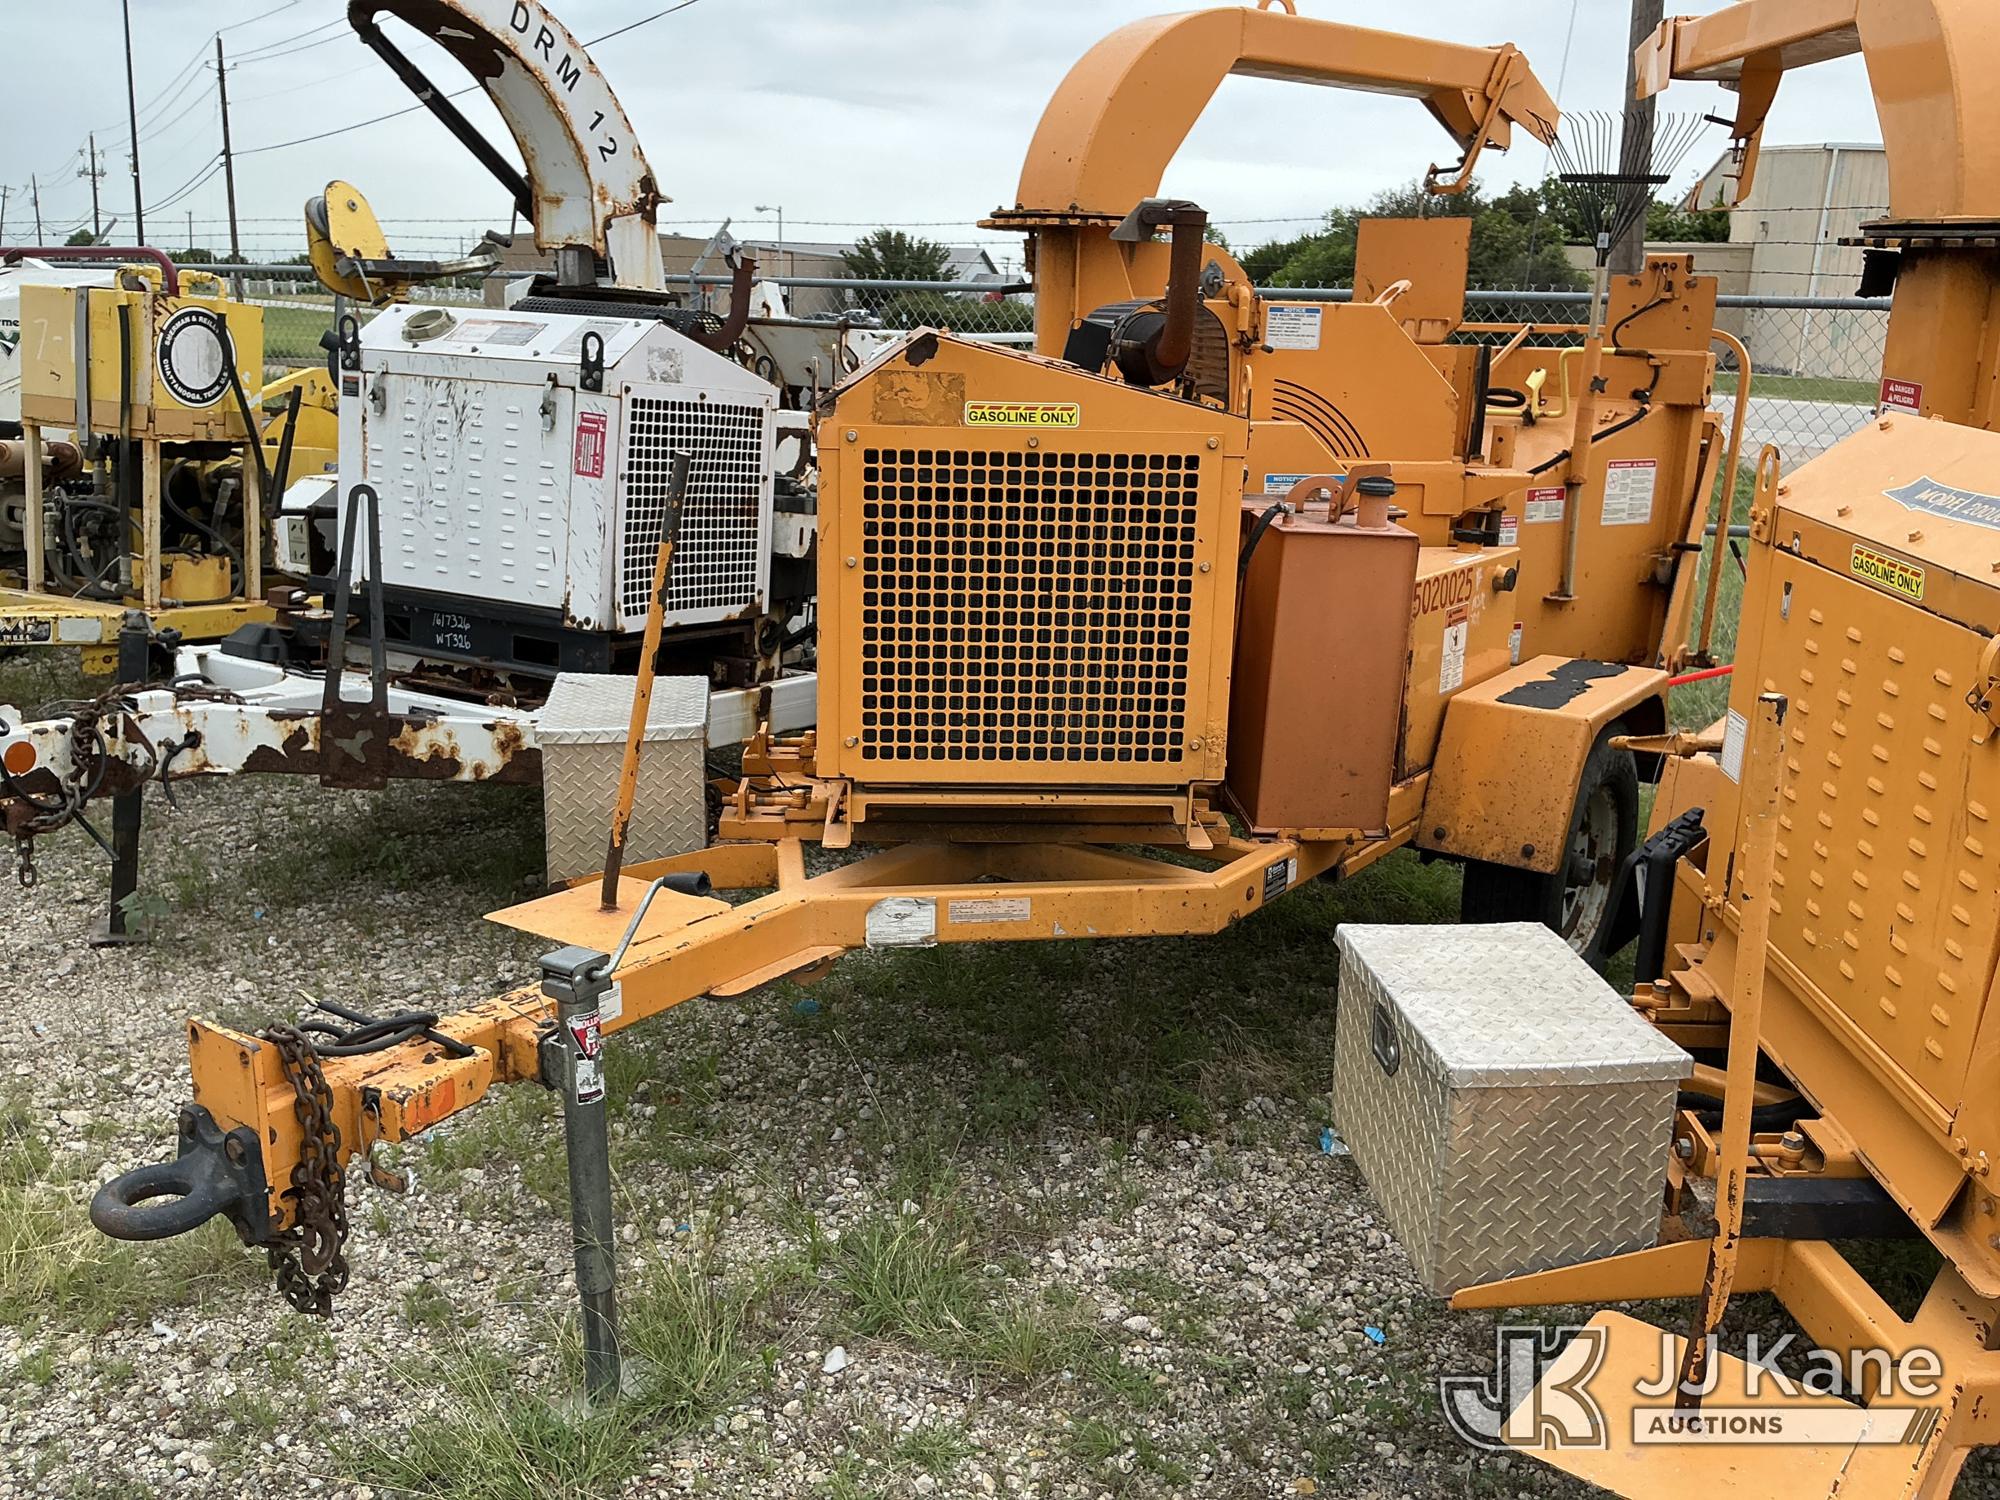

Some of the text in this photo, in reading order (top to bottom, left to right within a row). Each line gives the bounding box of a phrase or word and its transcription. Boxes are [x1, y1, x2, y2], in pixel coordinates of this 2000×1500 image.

[510, 1, 617, 163] DRM 12
[164, 315, 191, 346] SHERMAN
[198, 315, 219, 333] REILL
[1893, 394, 1914, 405] PELIGRO
[1895, 384, 1915, 395] DANGER
[968, 411, 1076, 423] GASOLINE ONLY
[1915, 488, 1966, 511] MODEL
[1853, 556, 1921, 594] GASOLINE ONLY
[1412, 567, 1474, 618] 5020025
[436, 633, 471, 650] WT326
